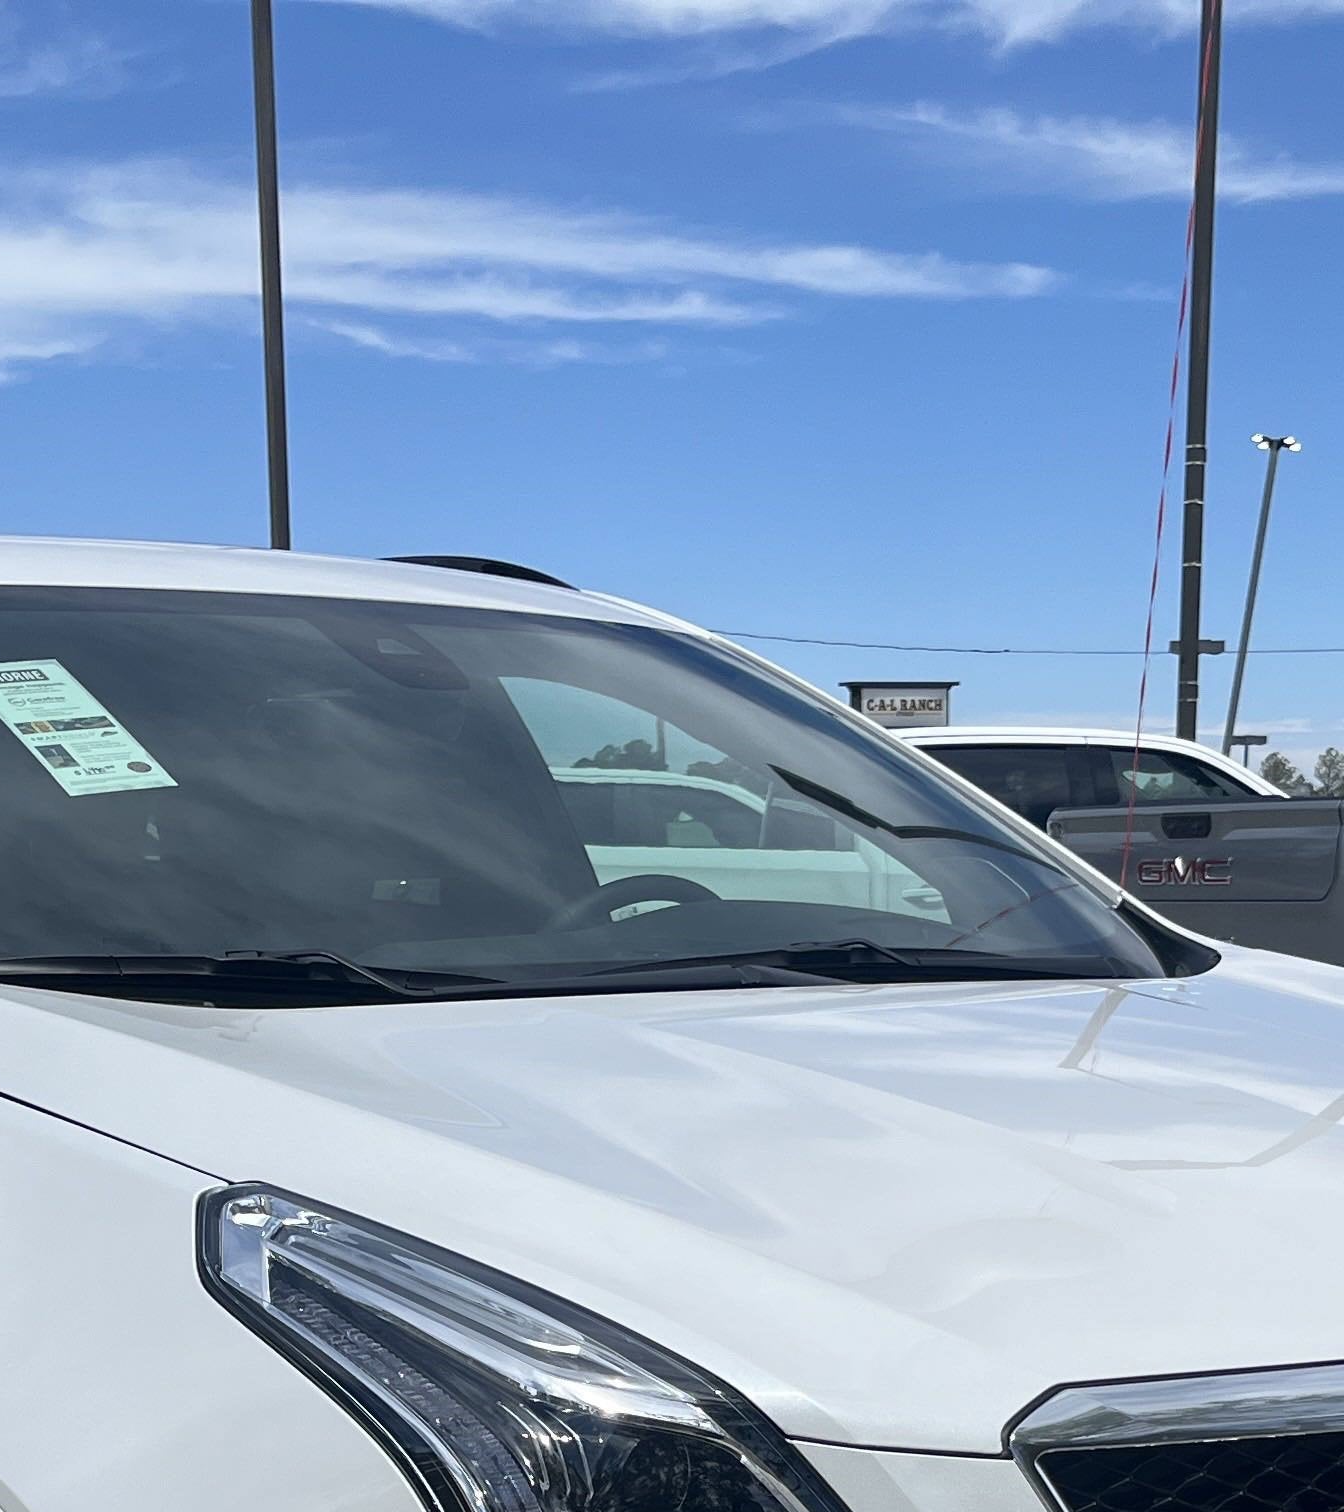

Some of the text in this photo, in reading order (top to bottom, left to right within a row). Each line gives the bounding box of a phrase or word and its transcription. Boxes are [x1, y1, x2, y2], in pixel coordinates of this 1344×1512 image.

[867, 699, 943, 711] C-A-L RANCH
[1138, 857, 1233, 885] GMC
